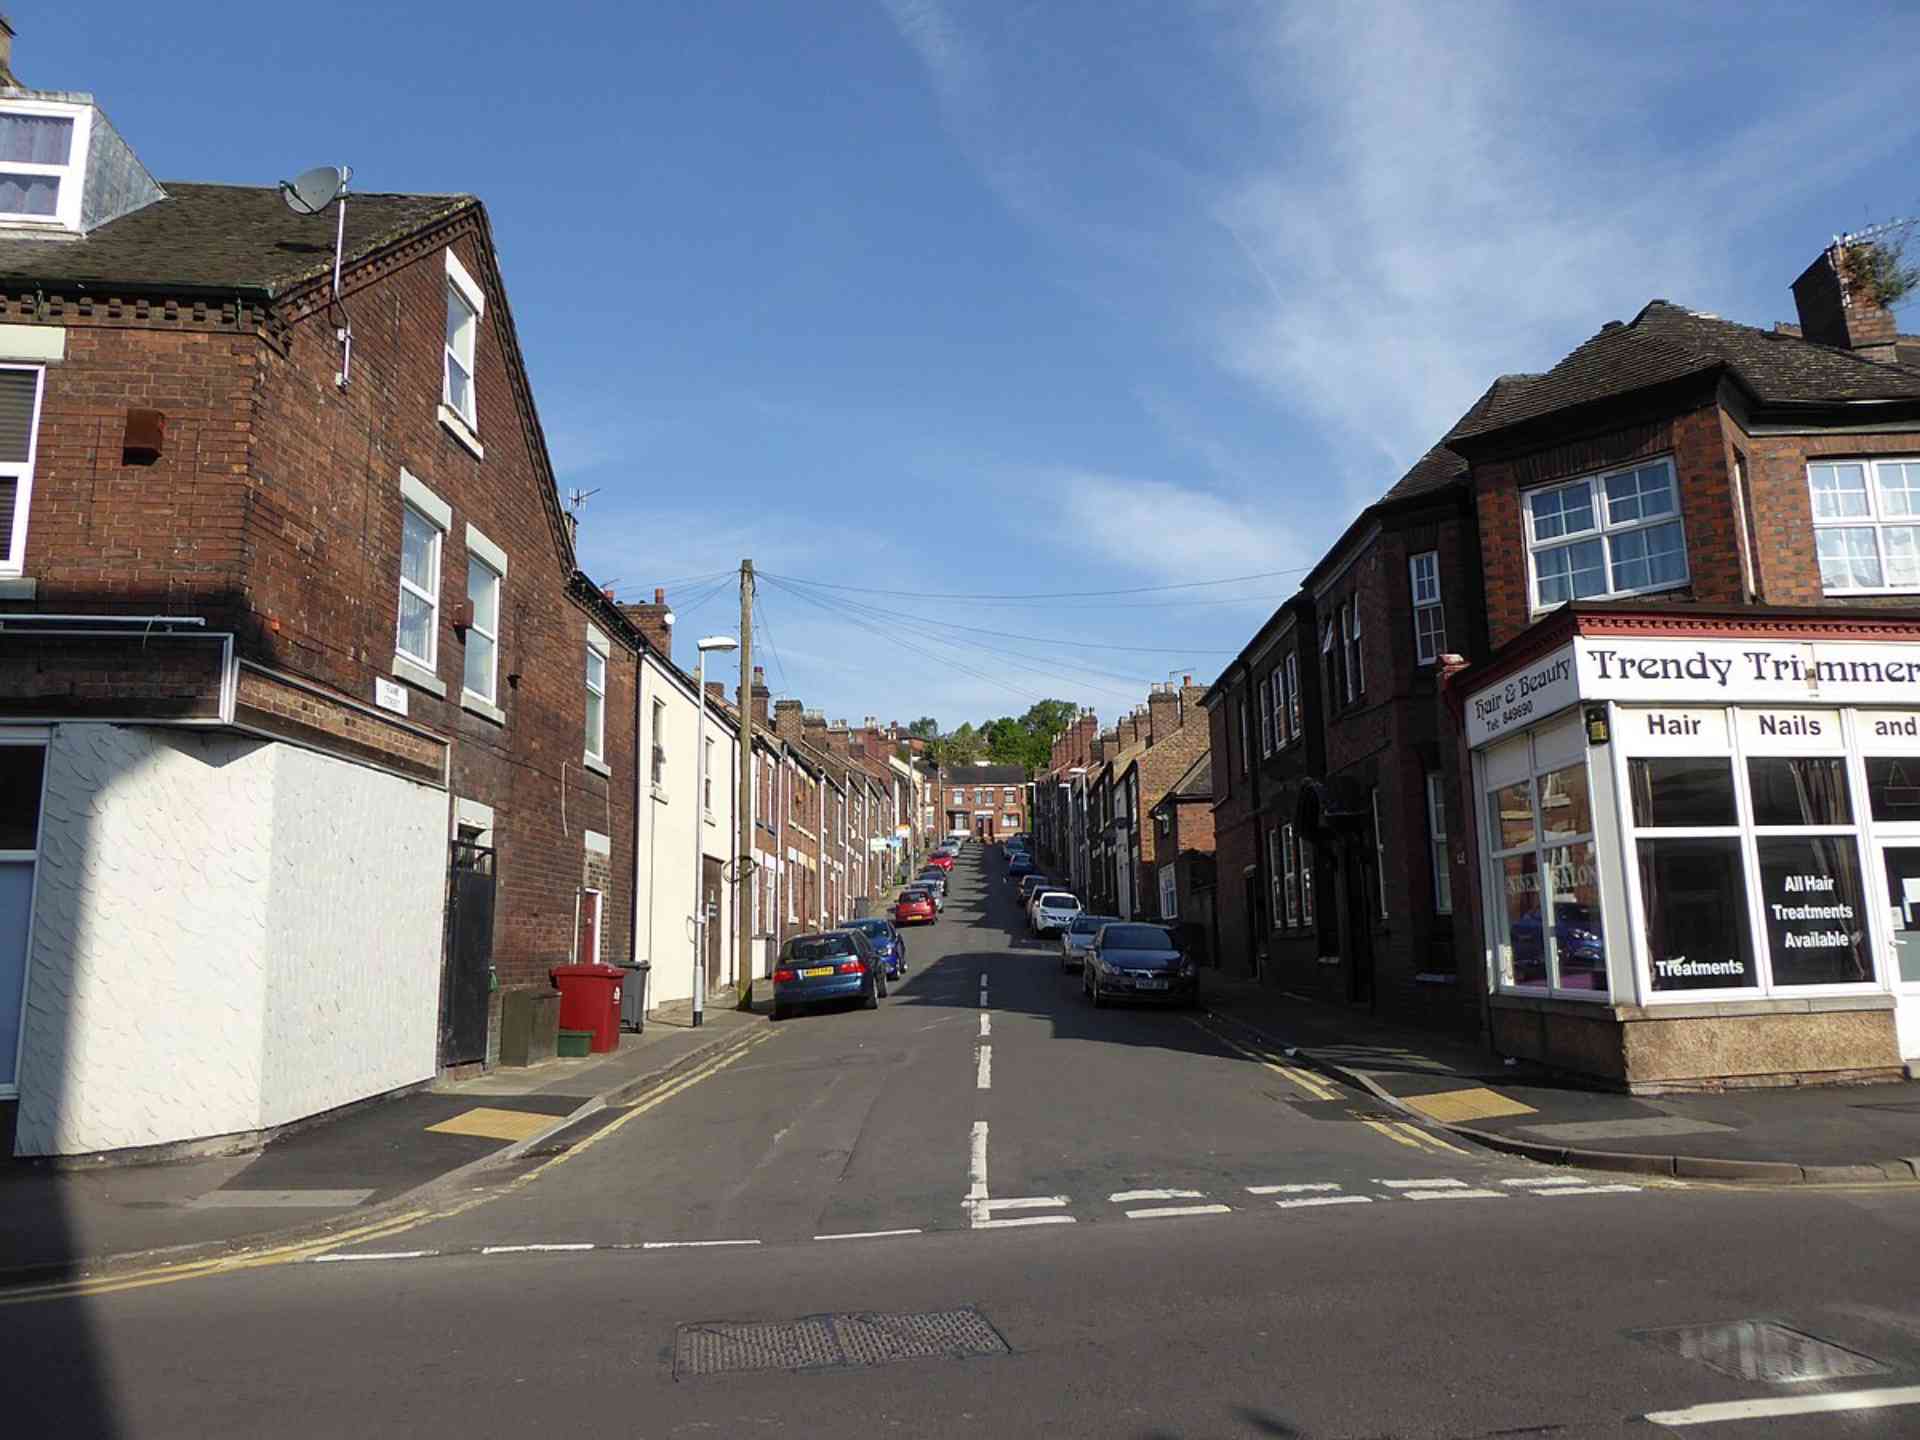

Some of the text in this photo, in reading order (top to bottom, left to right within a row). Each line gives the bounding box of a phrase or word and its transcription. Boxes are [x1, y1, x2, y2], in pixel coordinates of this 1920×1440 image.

[1587, 650, 1732, 686] Trendy
[1475, 659, 1570, 720] Hair & Beauty
[1648, 714, 1918, 736] Hair Nails and
[1785, 875, 1834, 892] All Hair
[1772, 904, 1854, 920] Treatments
[1785, 931, 1849, 948] Available
[1656, 959, 1744, 977] Treatments
